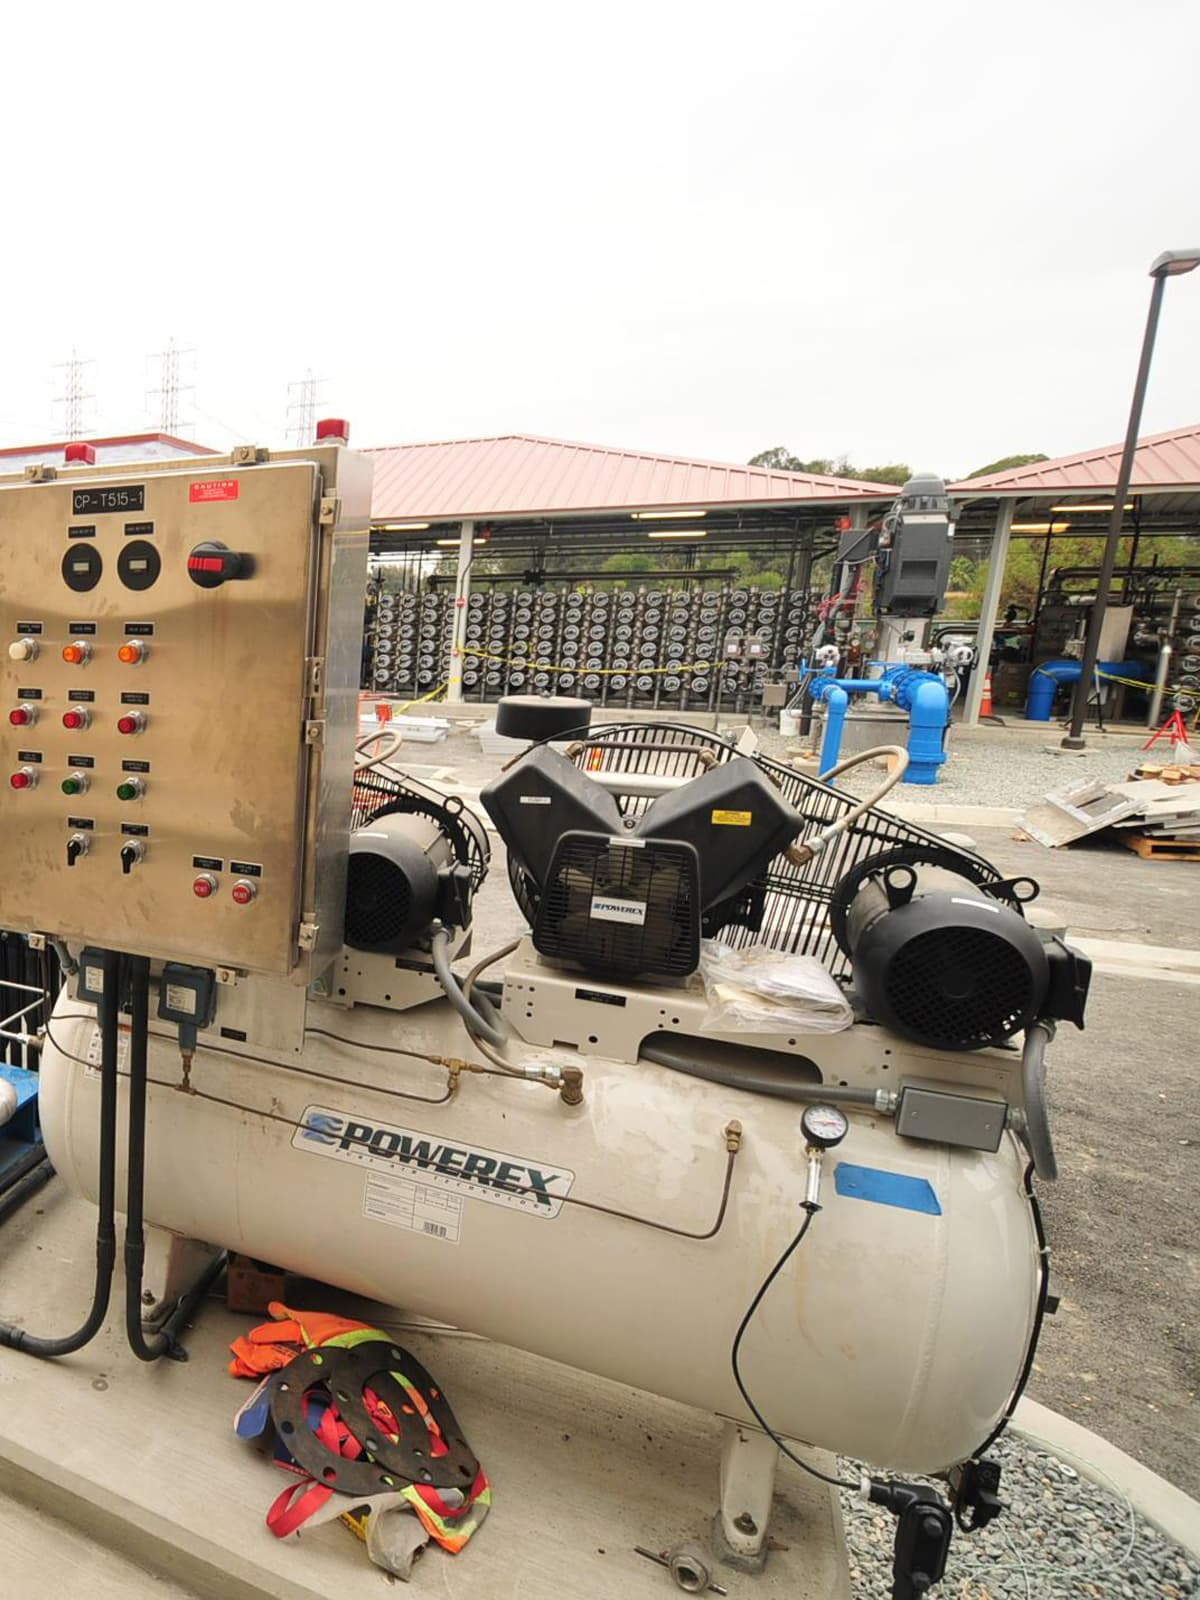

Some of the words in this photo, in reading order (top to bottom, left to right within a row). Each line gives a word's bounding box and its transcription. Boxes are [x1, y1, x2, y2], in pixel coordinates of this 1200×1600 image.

[74, 490, 143, 509] CP-T515-1
[601, 904, 643, 915] POWEREX
[339, 1121, 561, 1206] POWEREX
